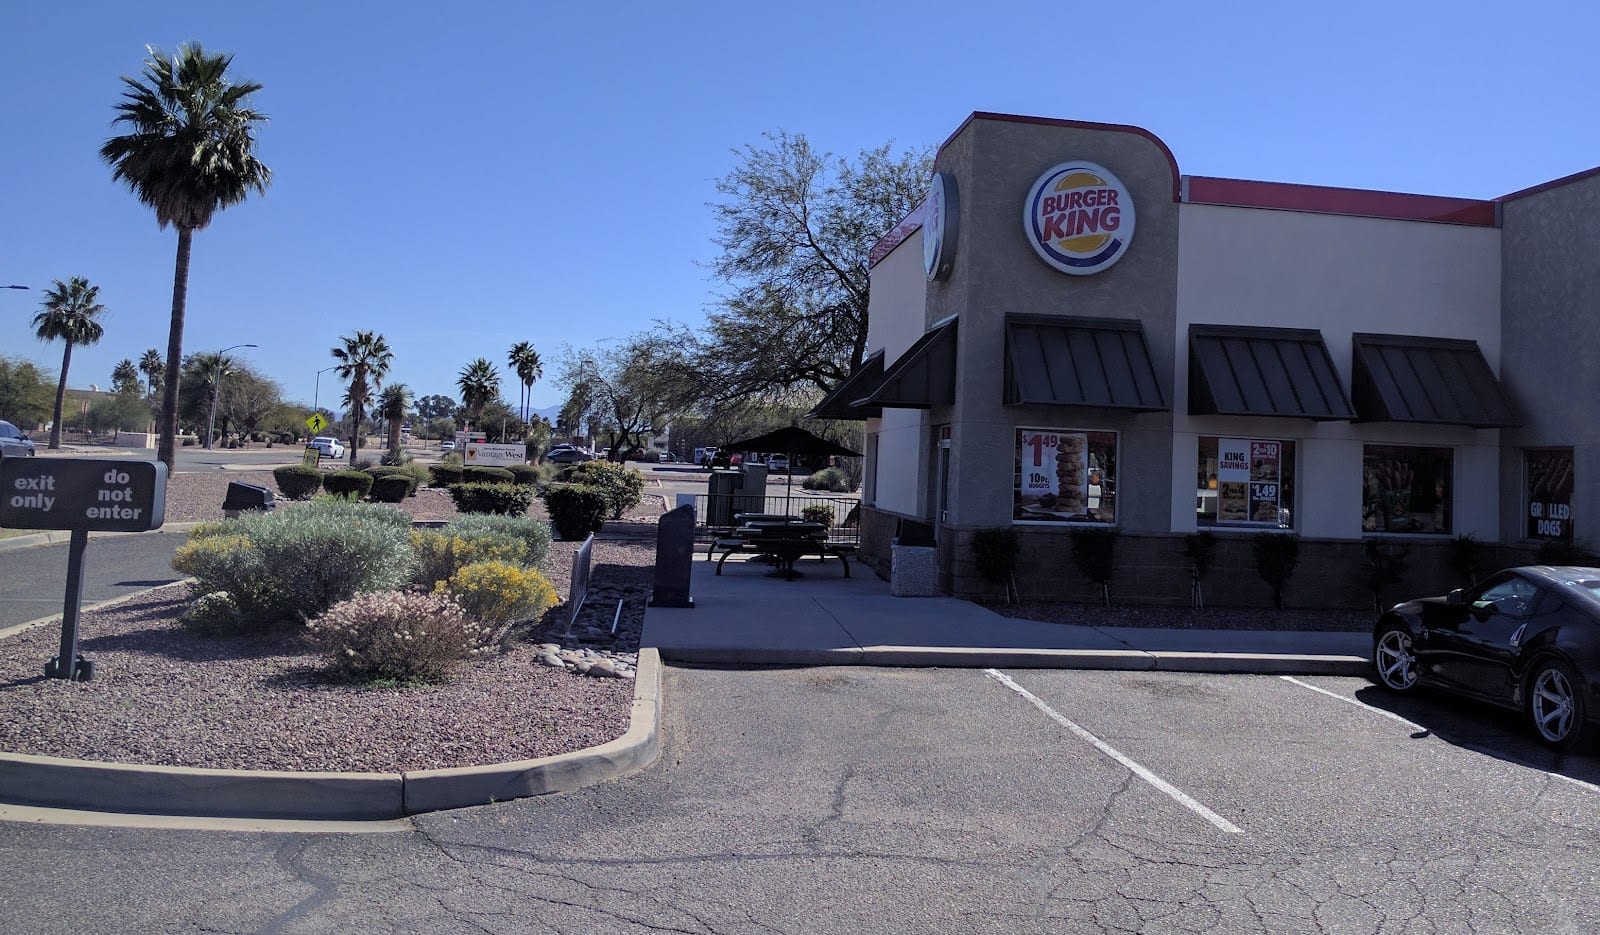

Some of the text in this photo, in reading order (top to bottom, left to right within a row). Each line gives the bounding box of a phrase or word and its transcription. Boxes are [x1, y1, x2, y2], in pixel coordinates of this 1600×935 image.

[1042, 189, 1119, 216] BURGER
[1042, 206, 1120, 242] KING
[1224, 452, 1245, 461] KING
[1219, 461, 1249, 470] SAVINGS
[14, 475, 56, 491] exit
[104, 469, 130, 484] do
[98, 487, 133, 502] not
[10, 493, 56, 512] only
[86, 506, 142, 520] enter
[1538, 520, 1561, 536] DOGS
